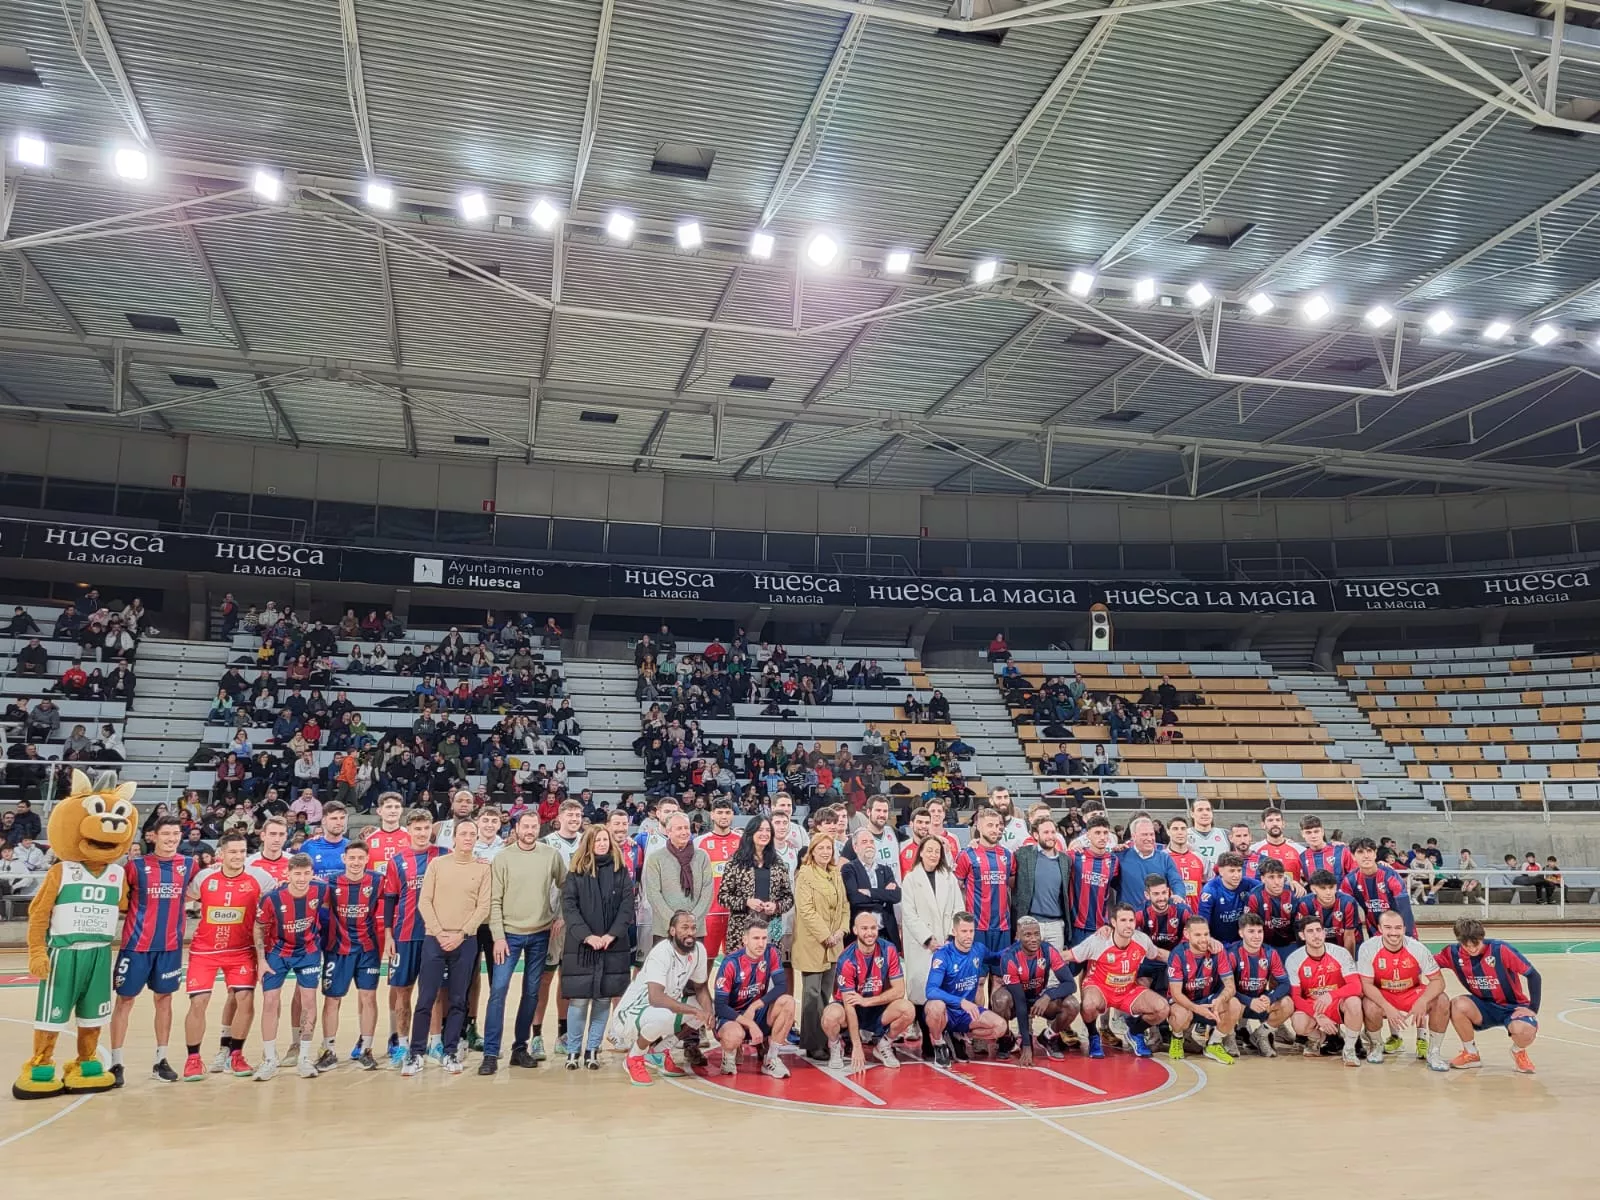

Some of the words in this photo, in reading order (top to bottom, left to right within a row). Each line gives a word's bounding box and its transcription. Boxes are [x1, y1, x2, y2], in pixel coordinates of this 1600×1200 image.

[44, 527, 165, 553] Huesca
[216, 542, 324, 565] Huesca
[448, 561, 544, 577] Ayuntamiento
[447, 574, 464, 586] de
[469, 576, 521, 589] Huesca
[624, 570, 715, 588] Huesca
[754, 575, 841, 593] Huesca
[1484, 572, 1591, 594] Huesca
[869, 583, 963, 602] Huesca
[1104, 587, 1200, 606] Huesca
[1345, 581, 1441, 598] Huesca
[722, 846, 728, 859] 5
[878, 848, 891, 860] 16
[1199, 846, 1214, 856] 27
[82, 886, 106, 902] 00
[224, 892, 232, 906] 9
[214, 911, 237, 919] Bada
[118, 957, 130, 973] 5
[326, 962, 336, 977] 2
[1121, 960, 1130, 973] 10
